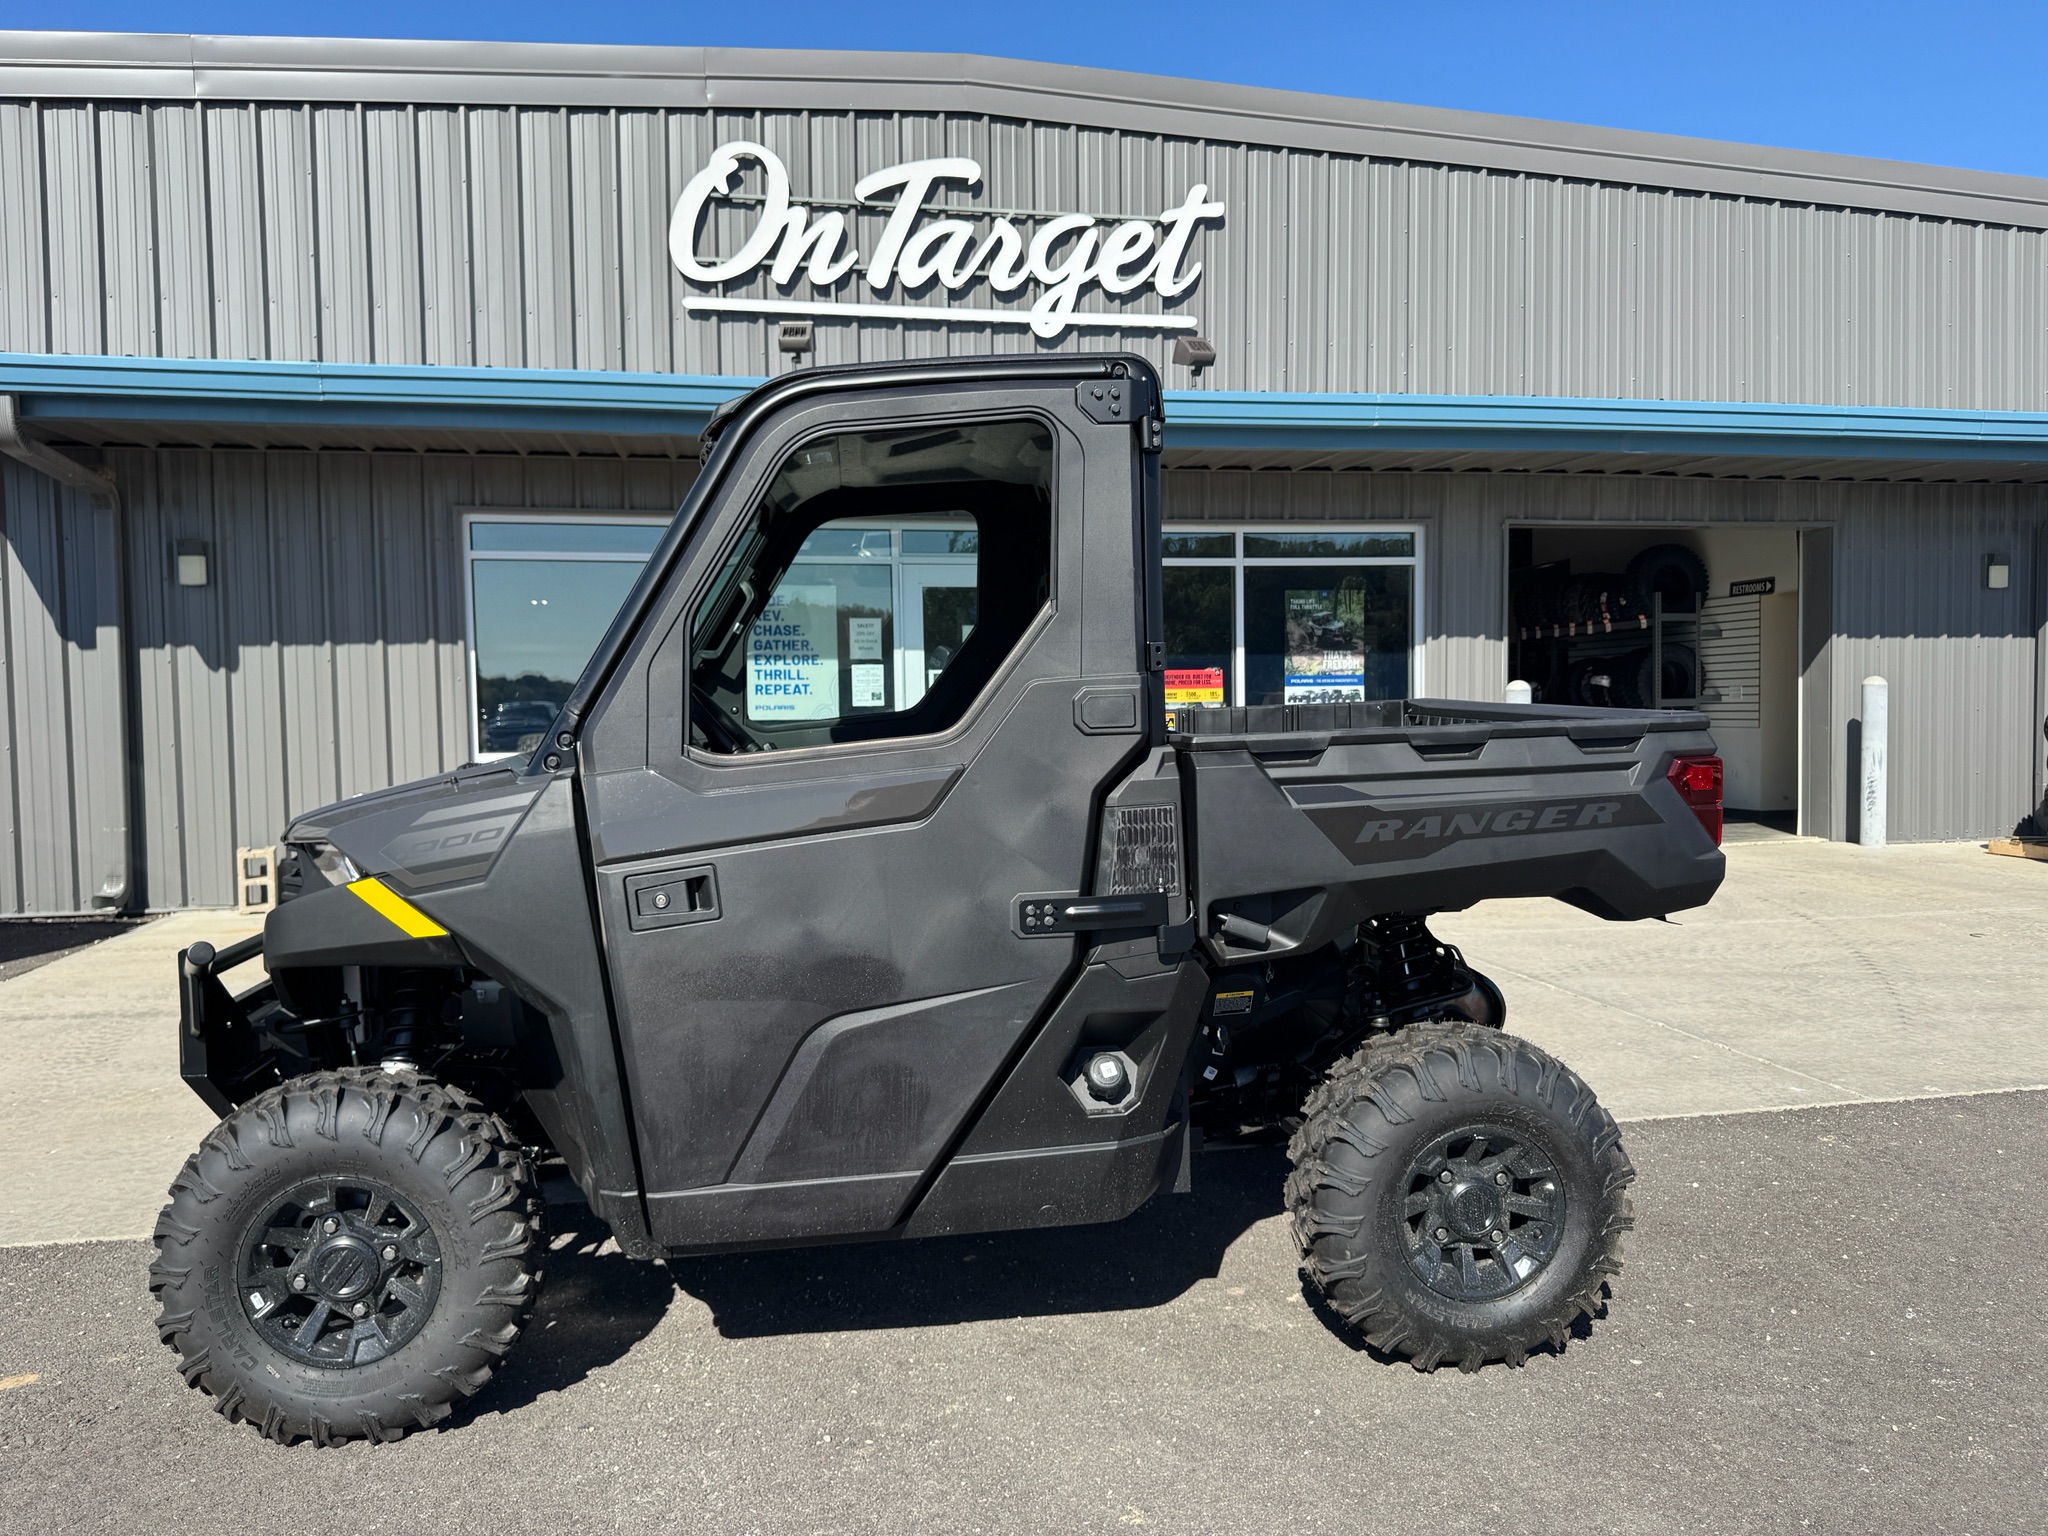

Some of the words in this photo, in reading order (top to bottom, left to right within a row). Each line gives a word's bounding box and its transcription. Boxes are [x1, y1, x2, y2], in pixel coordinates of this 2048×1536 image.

[1732, 581, 1765, 595] RESTROOMS
[758, 610, 785, 621] EV.
[753, 624, 805, 636] CHASE.
[753, 639, 814, 651] GATHER.
[754, 654, 824, 666] EXPLORE.
[1322, 650, 1352, 660] THAT'S
[1322, 660, 1360, 669] FREEDOM
[754, 669, 809, 681] THRILL.
[755, 684, 813, 695] REPEAT.
[1354, 802, 1621, 844] RANGER
[203, 1264, 258, 1372] CARLSTAR
